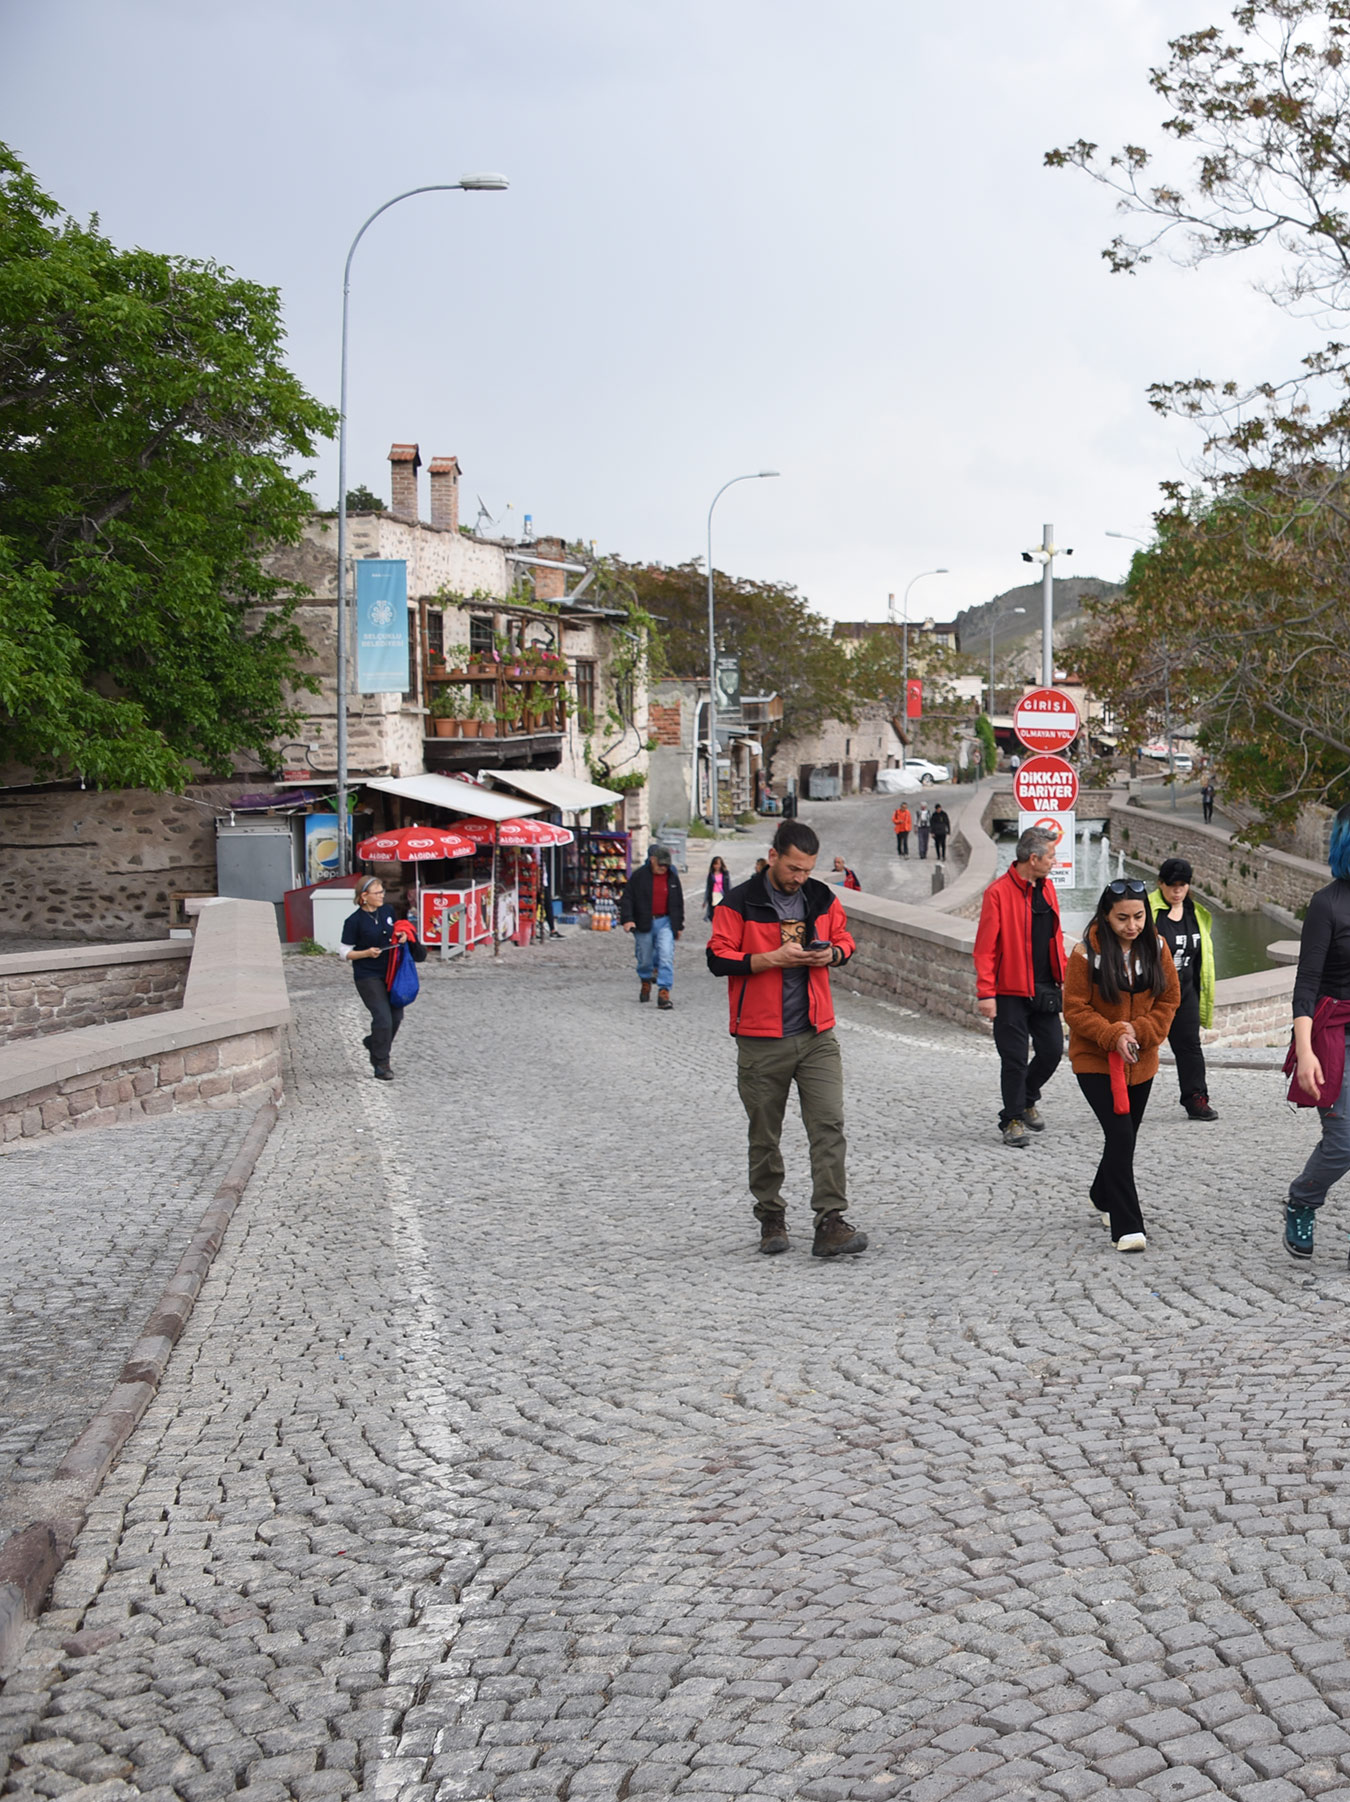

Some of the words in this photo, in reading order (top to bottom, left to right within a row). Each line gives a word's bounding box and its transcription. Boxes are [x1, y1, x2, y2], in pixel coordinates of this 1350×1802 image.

[1023, 699, 1067, 712] GİRİŞİ
[1020, 729, 1056, 738] OLMAYAN
[1057, 730, 1072, 739] YOL
[1019, 771, 1073, 785] DİKKAT!
[1019, 785, 1073, 798] BARİYER
[1033, 798, 1059, 811] VAR
[409, 851, 436, 860] ALGIDA
